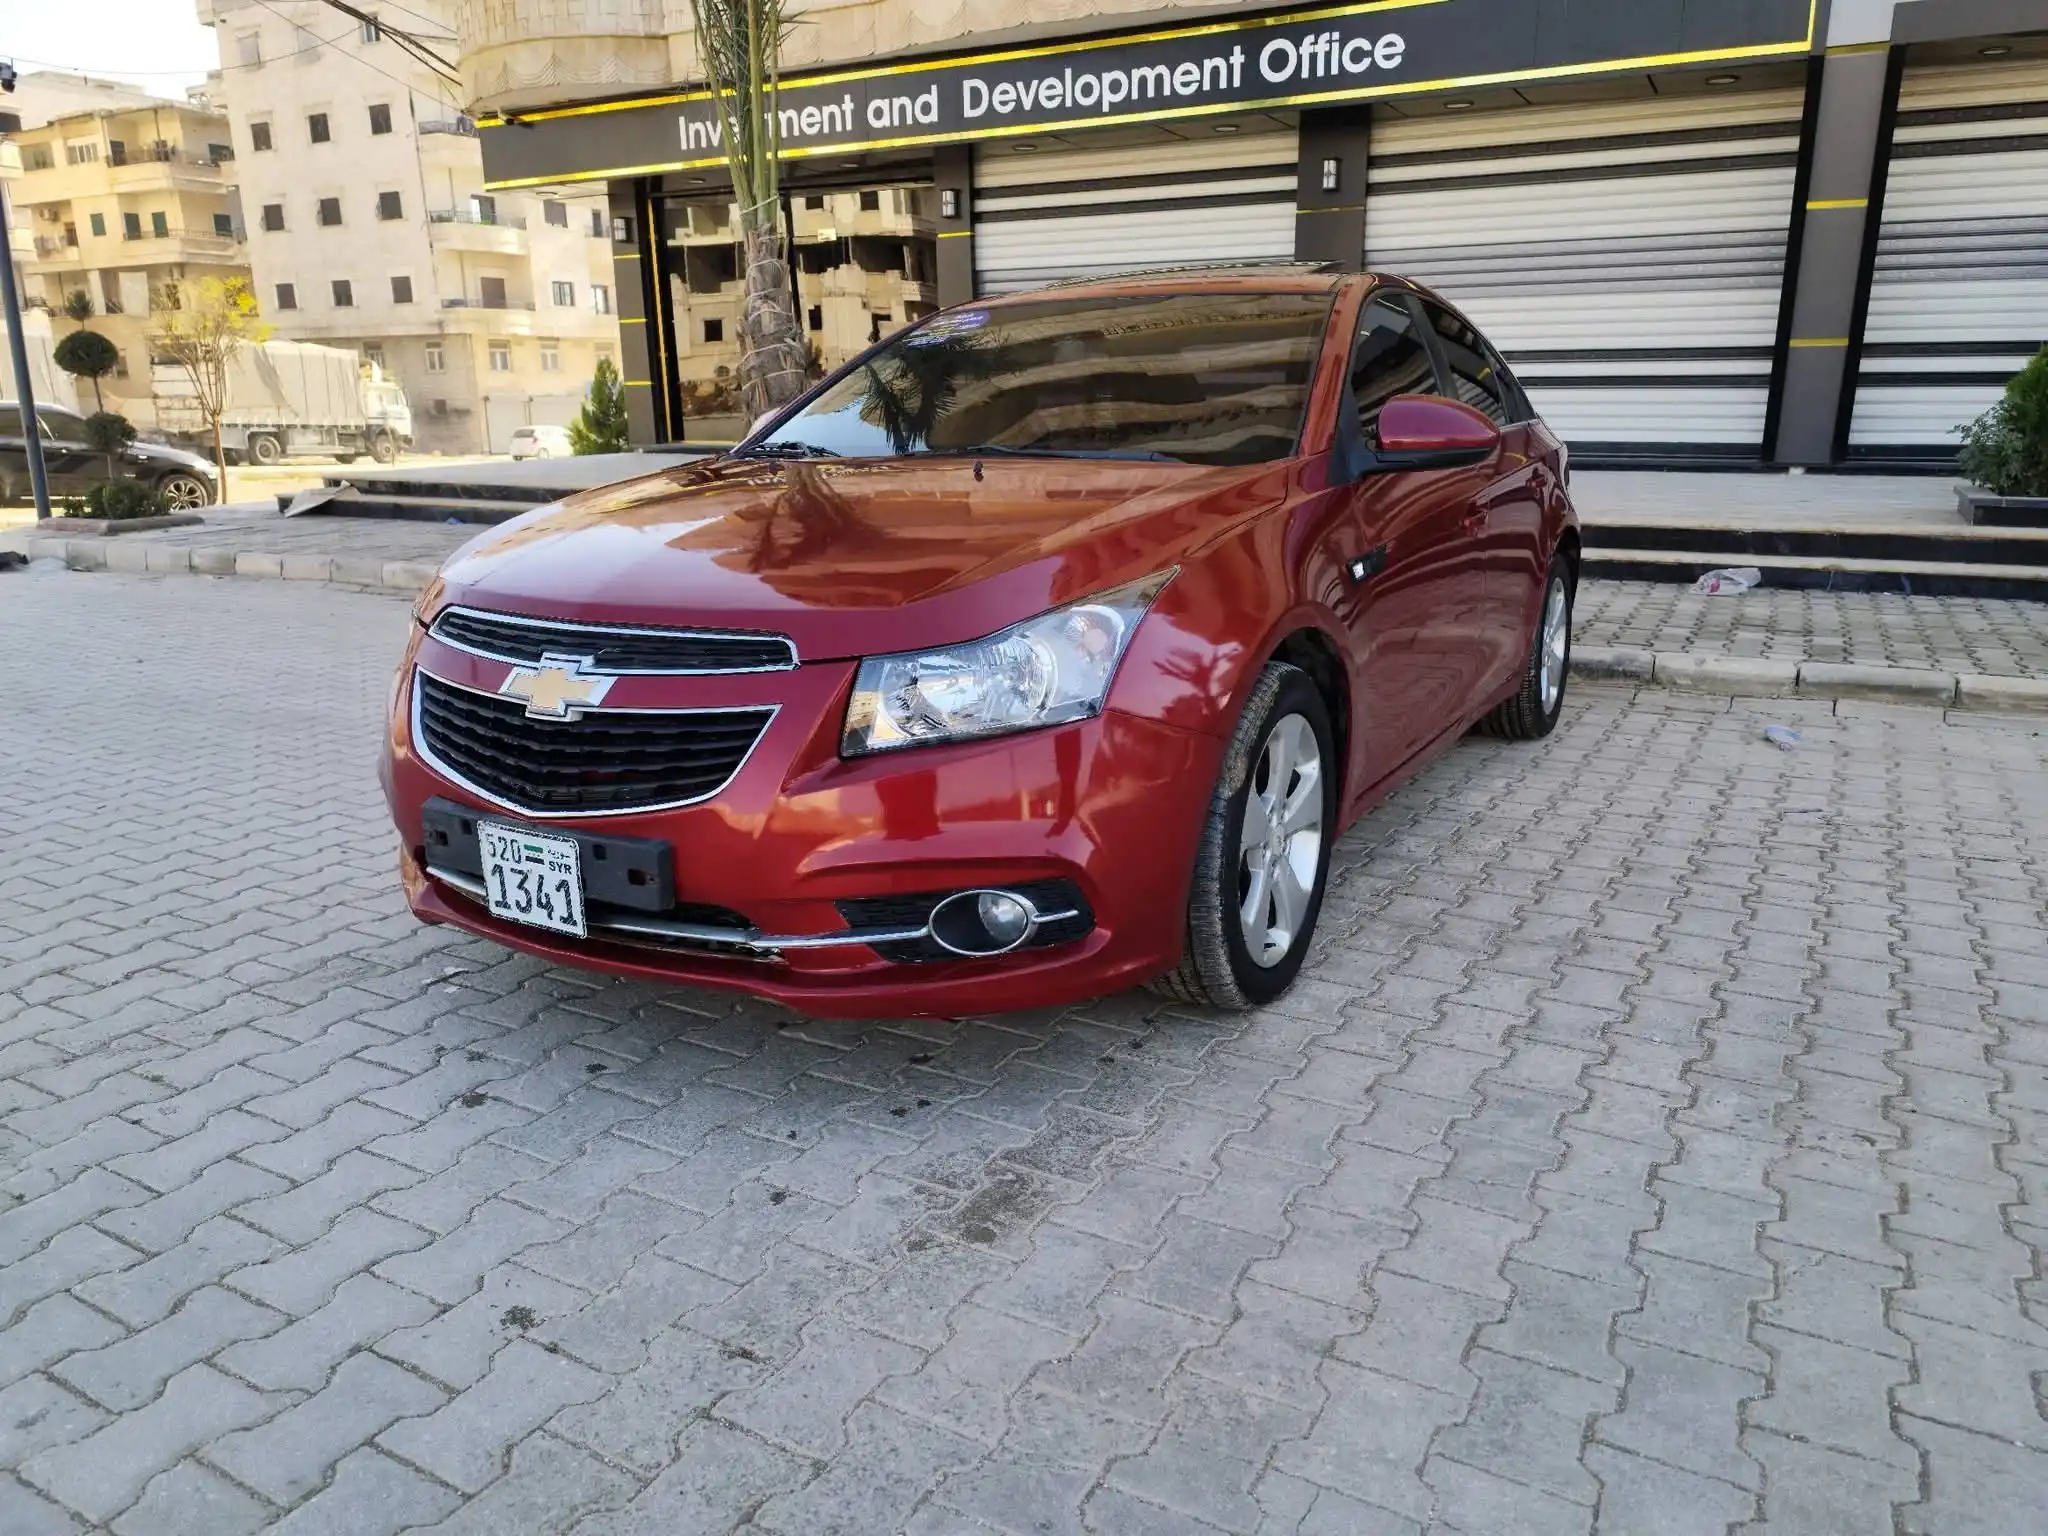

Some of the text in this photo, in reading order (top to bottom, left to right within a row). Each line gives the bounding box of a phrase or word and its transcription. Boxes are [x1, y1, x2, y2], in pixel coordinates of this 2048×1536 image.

[866, 85, 939, 129] and
[963, 44, 1245, 118] Development
[1258, 31, 1407, 84] Office
[484, 833, 522, 864] 520
[548, 860, 573, 875] SYR
[491, 863, 578, 927] 1341
